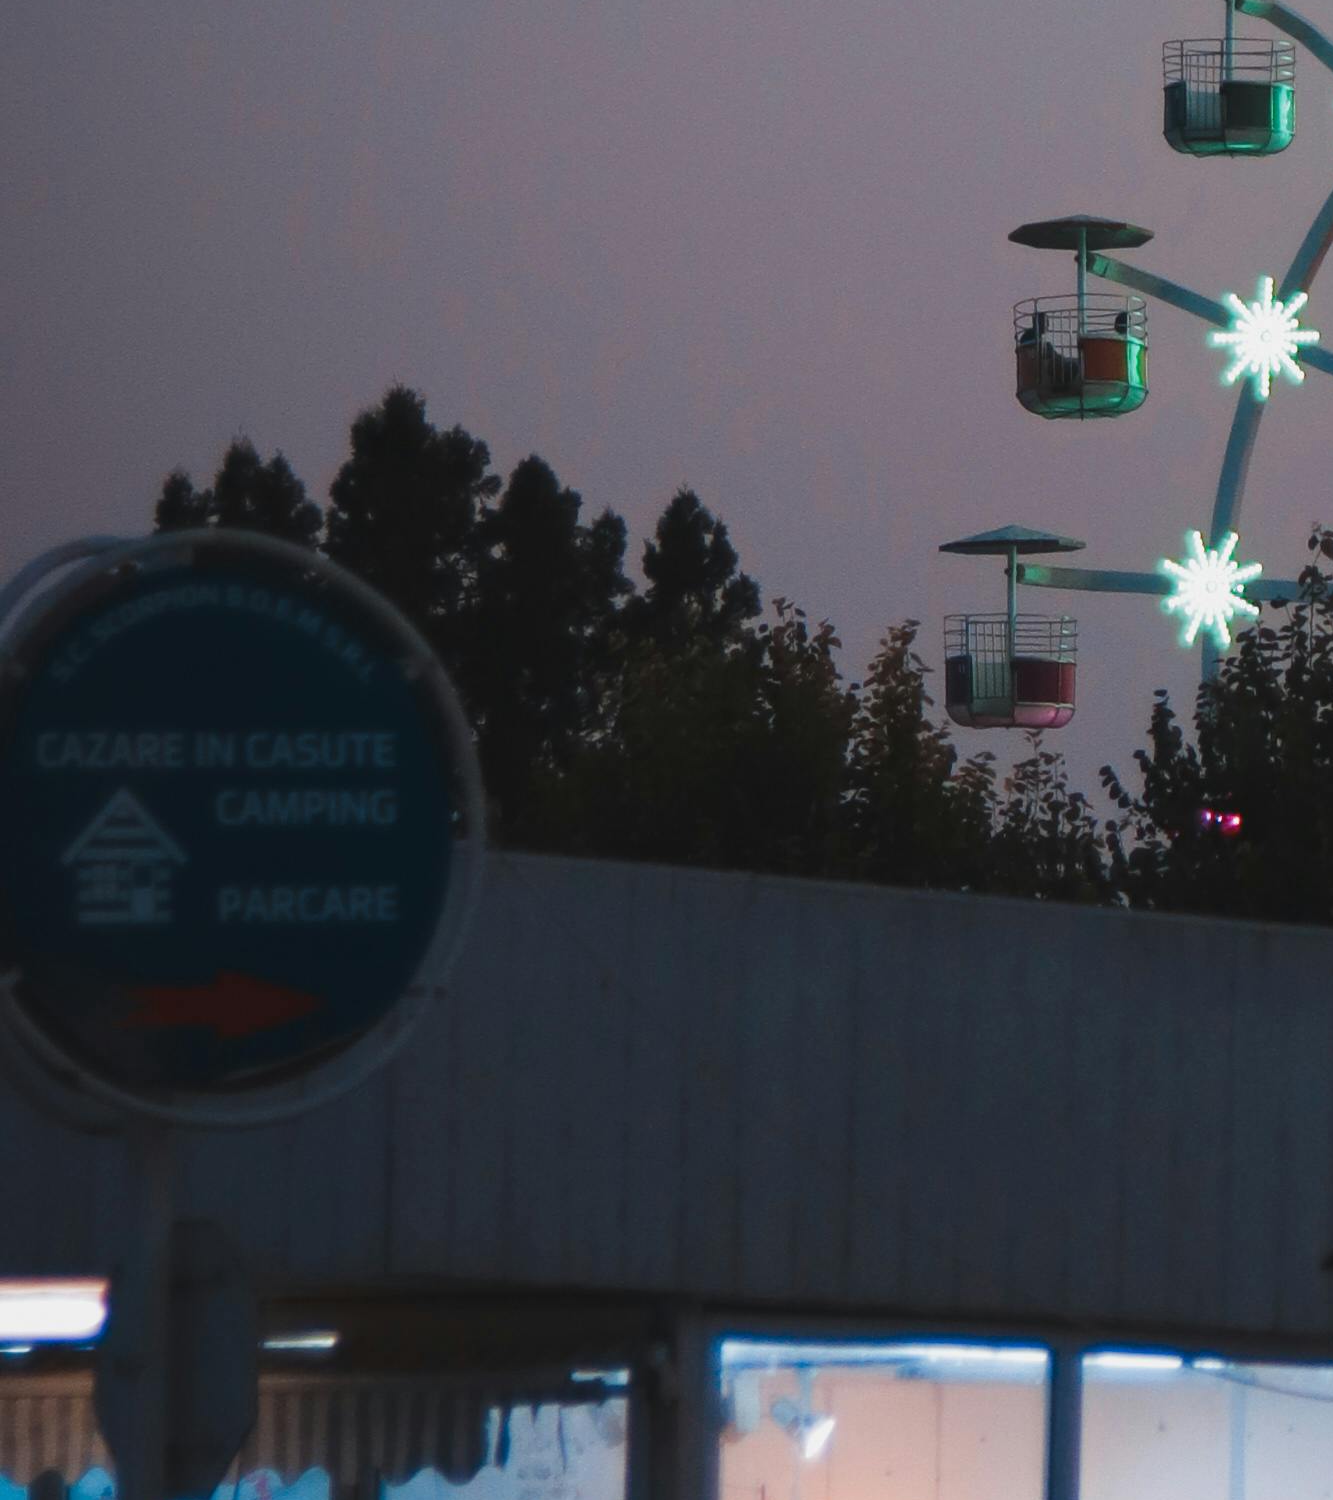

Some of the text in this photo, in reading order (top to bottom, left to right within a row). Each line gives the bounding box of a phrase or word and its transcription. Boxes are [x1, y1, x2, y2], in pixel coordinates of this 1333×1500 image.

[88, 584, 219, 643] SCORPION
[35, 730, 397, 769] CAZARE IN CASUTE
[215, 788, 398, 826] CAMPING
[218, 884, 400, 923] PARCARE
